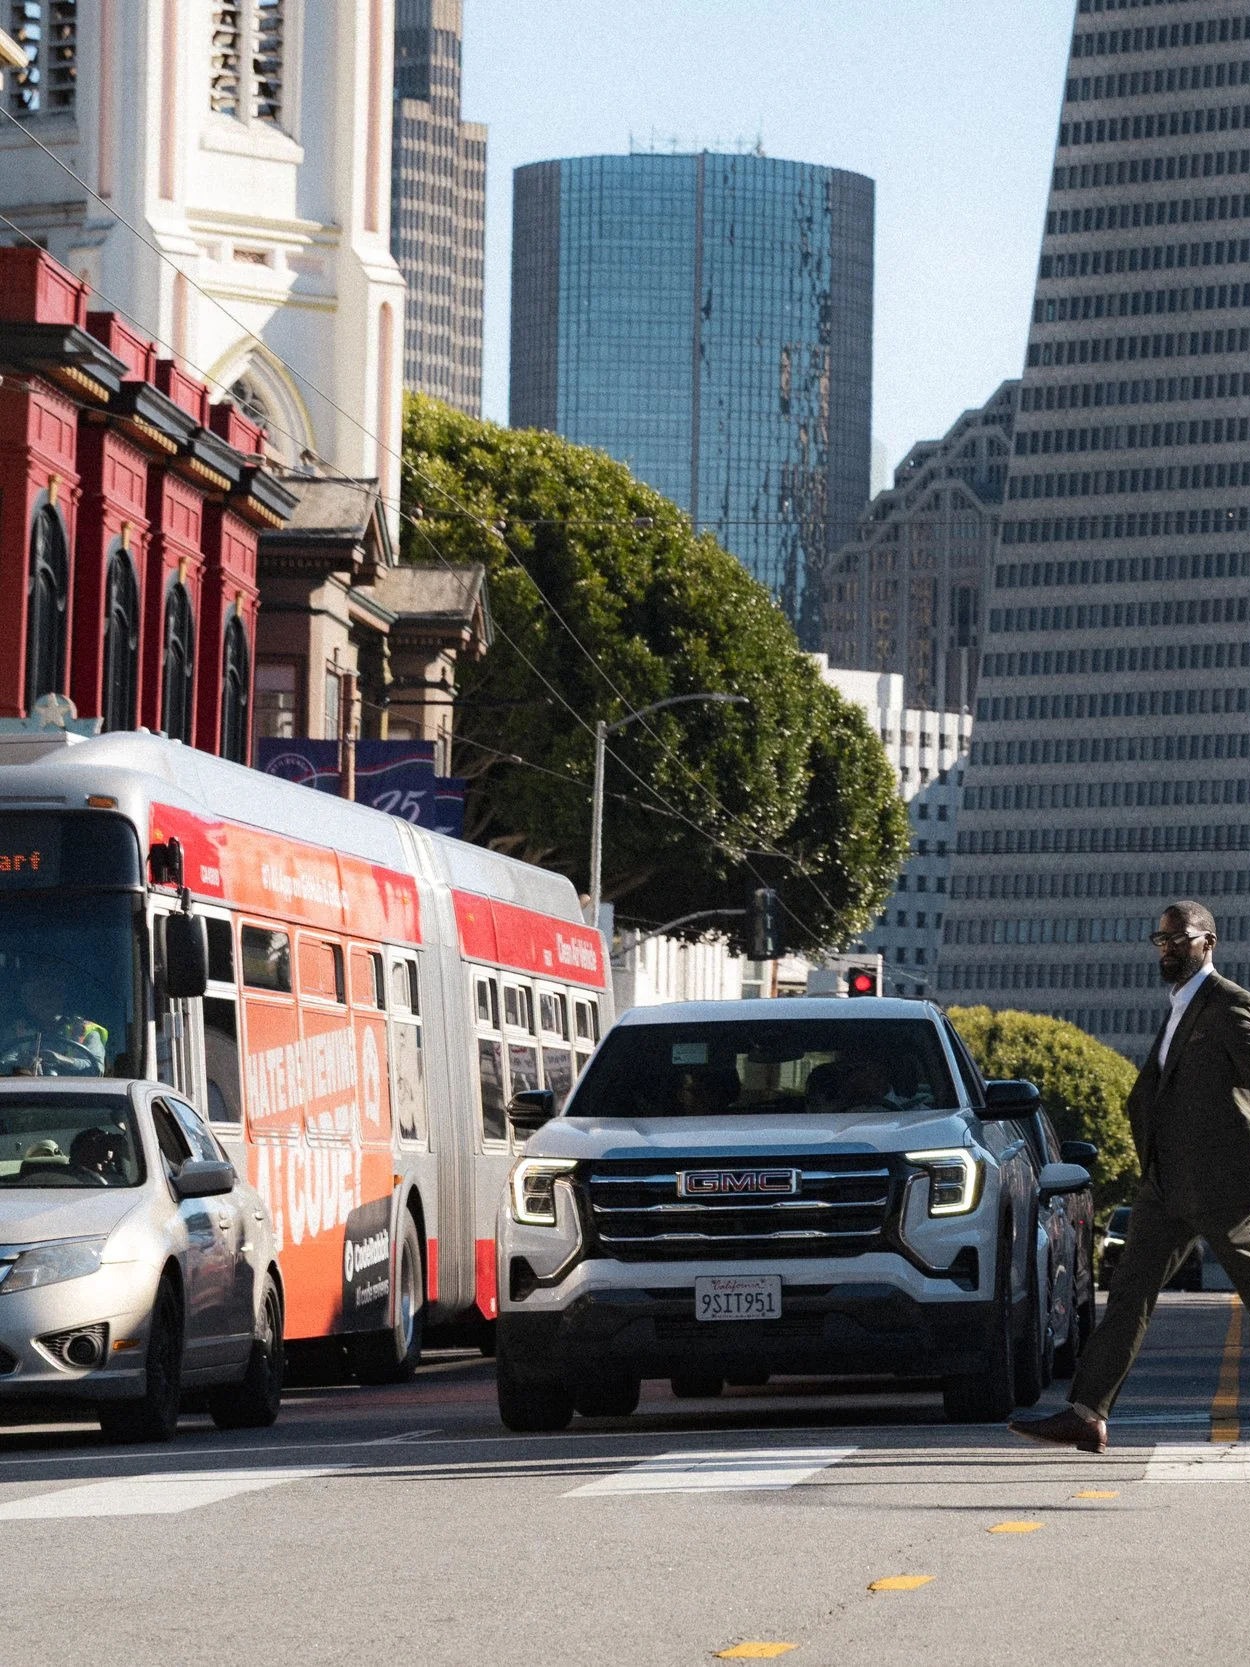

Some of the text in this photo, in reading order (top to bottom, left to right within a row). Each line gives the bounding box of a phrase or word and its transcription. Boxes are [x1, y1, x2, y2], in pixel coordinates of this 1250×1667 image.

[247, 1047, 287, 1120] HATE
[687, 1172, 790, 1192] GMC
[714, 1280, 765, 1292] California
[702, 1292, 775, 1314] 9SIT951
